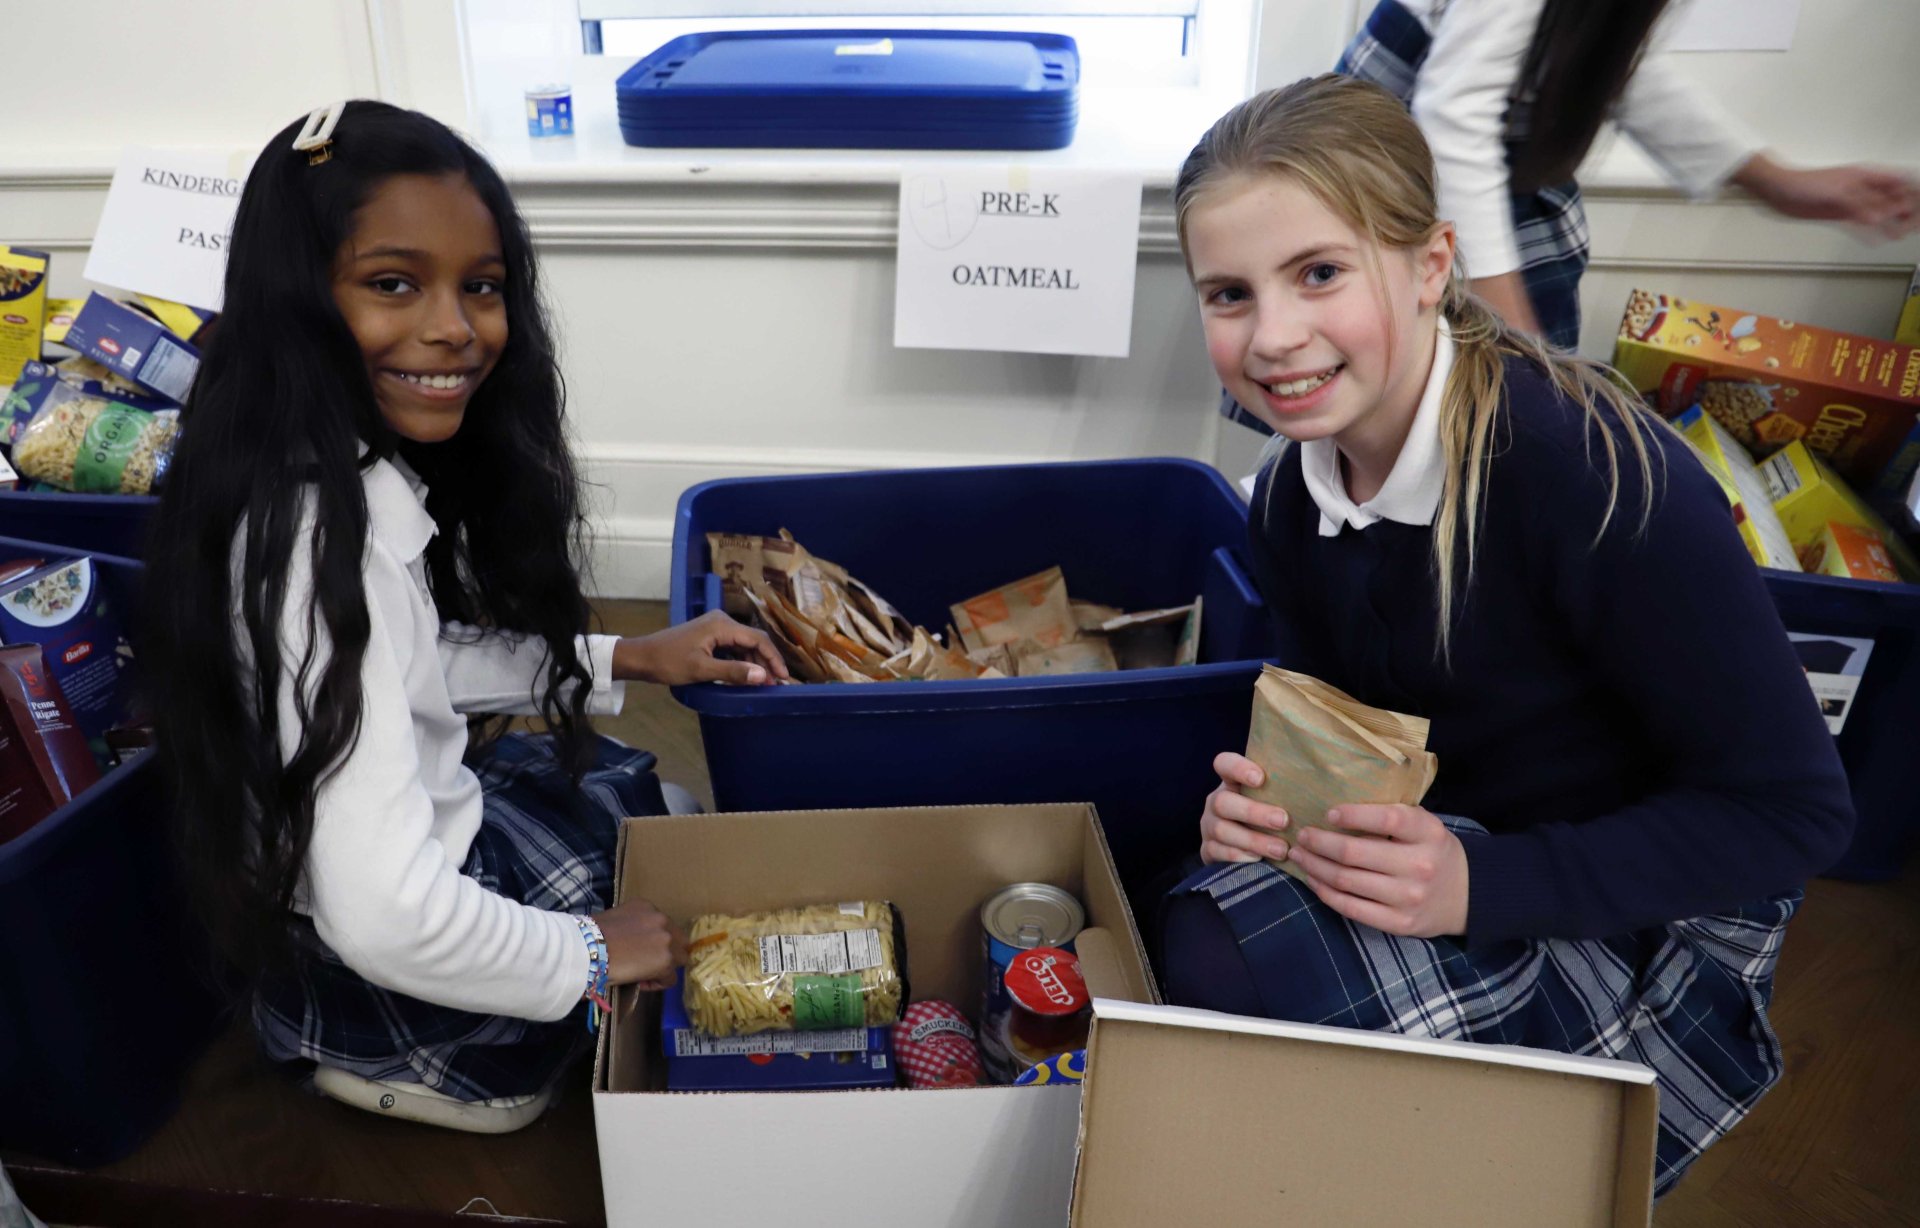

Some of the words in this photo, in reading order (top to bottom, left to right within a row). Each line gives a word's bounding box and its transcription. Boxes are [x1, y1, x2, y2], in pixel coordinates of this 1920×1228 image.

[142, 167, 246, 197] KINDERG
[980, 191, 1060, 217] PRE-K
[952, 264, 1080, 290] OATMEAL
[65, 644, 91, 662] Barilla
[31, 700, 56, 711] Penne
[35, 709, 61, 721] Rigate
